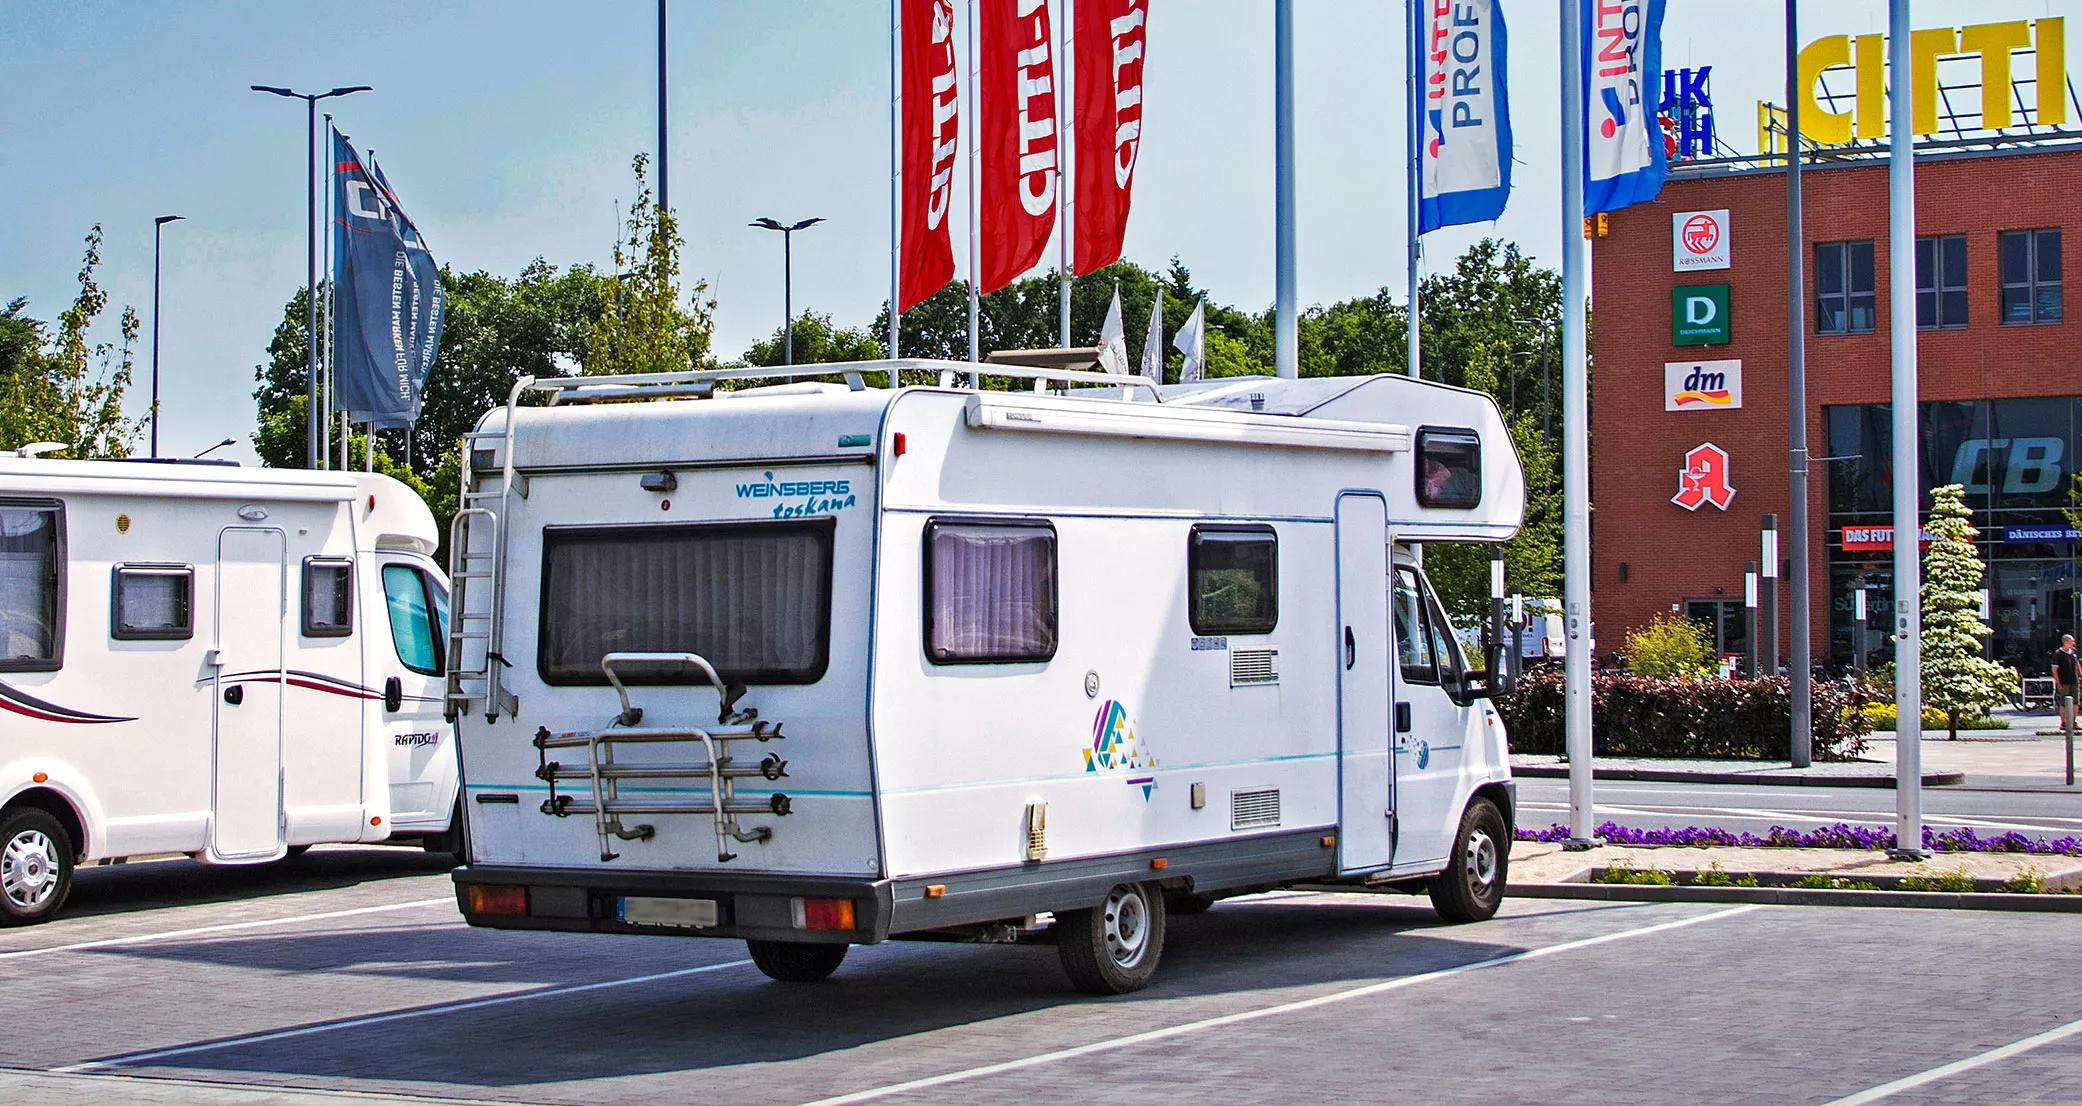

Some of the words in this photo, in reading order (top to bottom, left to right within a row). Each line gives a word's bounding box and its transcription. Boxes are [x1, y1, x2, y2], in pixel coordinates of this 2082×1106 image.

[1452, 3, 1482, 128] PROF
[1797, 16, 2066, 145] CITTI
[1679, 256, 1723, 265] ROSSMANN
[1686, 296, 1716, 325] D
[1684, 366, 1725, 391] dm
[1950, 437, 2064, 494] CB
[736, 480, 850, 498] WEINSBERG
[1846, 529, 1869, 542] DAS
[2008, 529, 2063, 539] DÄNISCHES
[395, 732, 431, 747] RAPIDO
